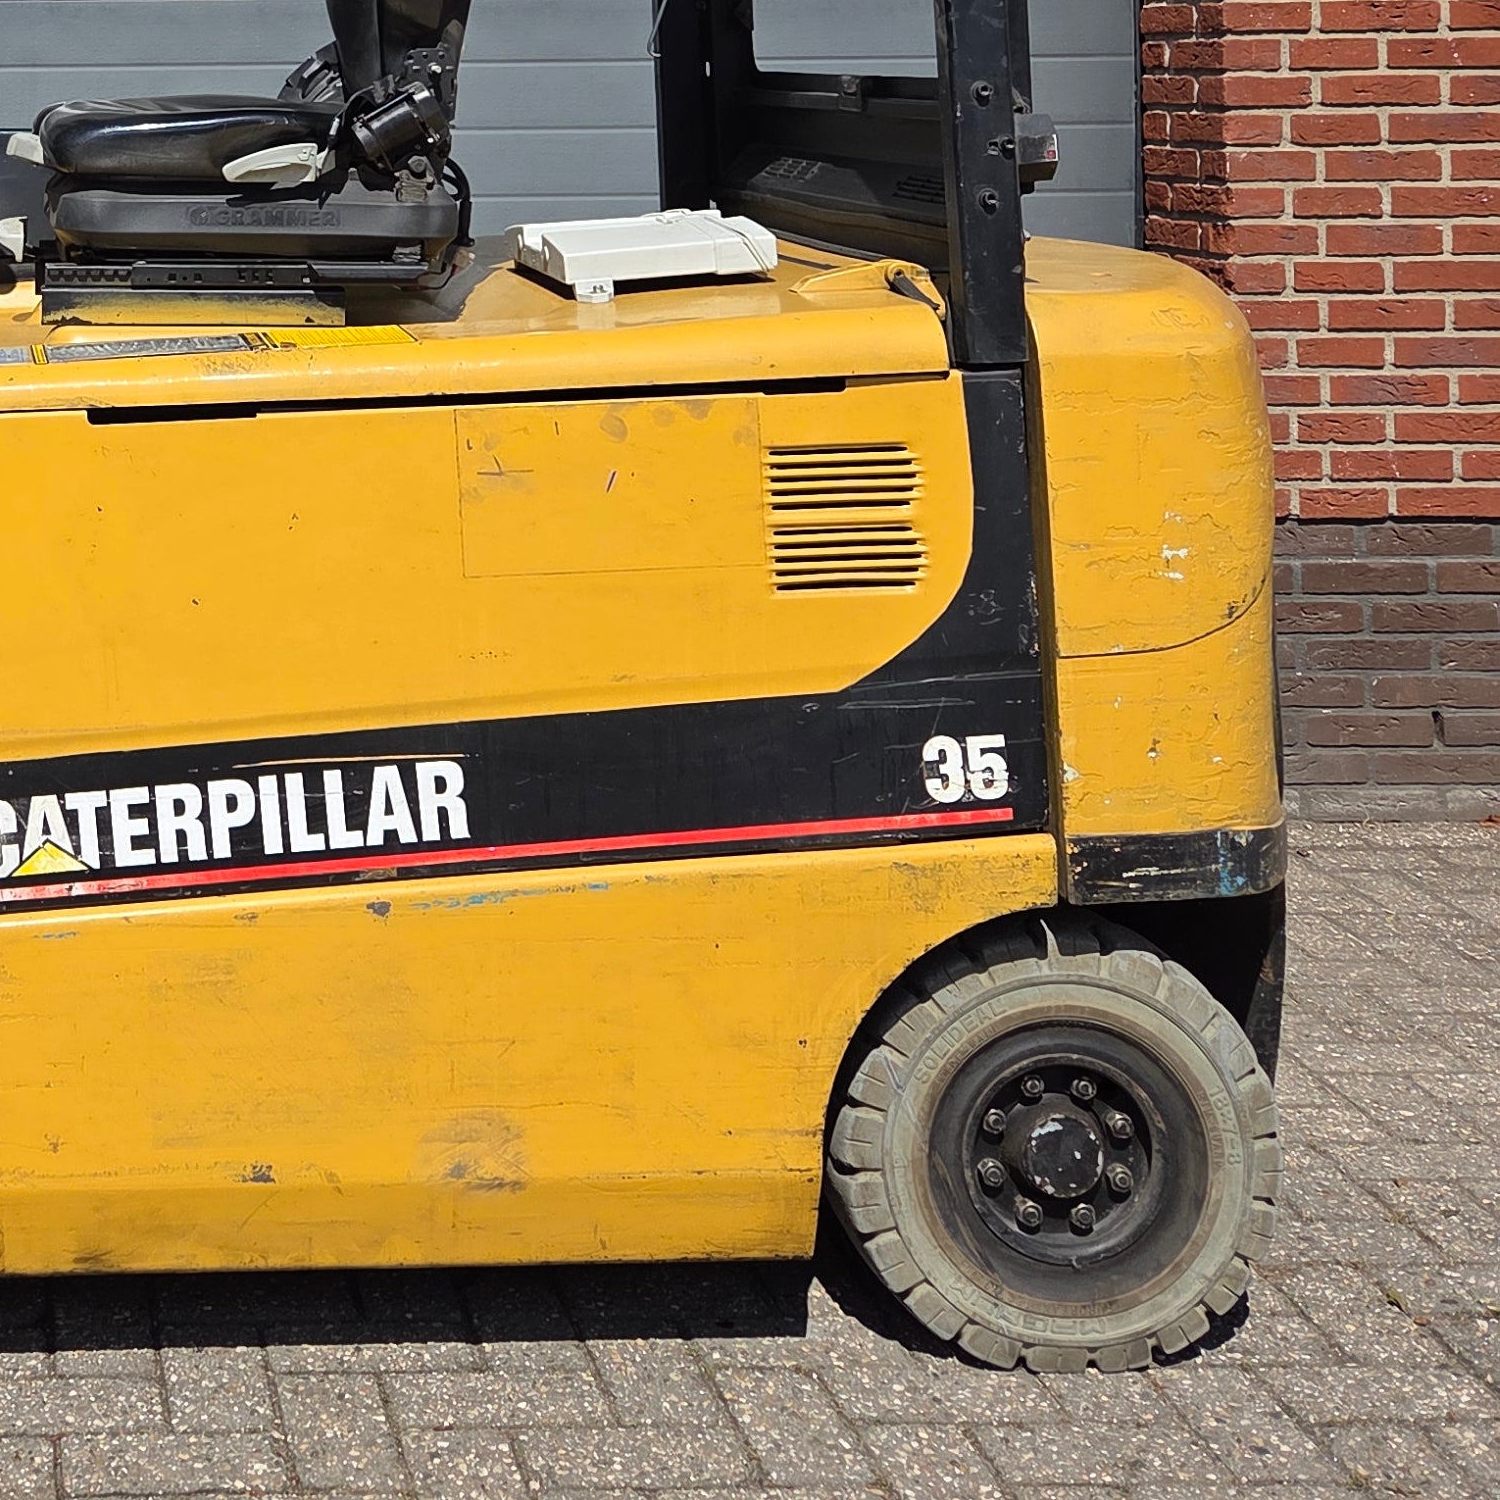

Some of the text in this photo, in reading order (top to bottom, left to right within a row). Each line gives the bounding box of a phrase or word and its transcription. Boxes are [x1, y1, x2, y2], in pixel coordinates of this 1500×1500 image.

[214, 208, 337, 227] GRAMMER
[922, 734, 1009, 803] 35
[914, 998, 1008, 1085] SOLIDEAL
